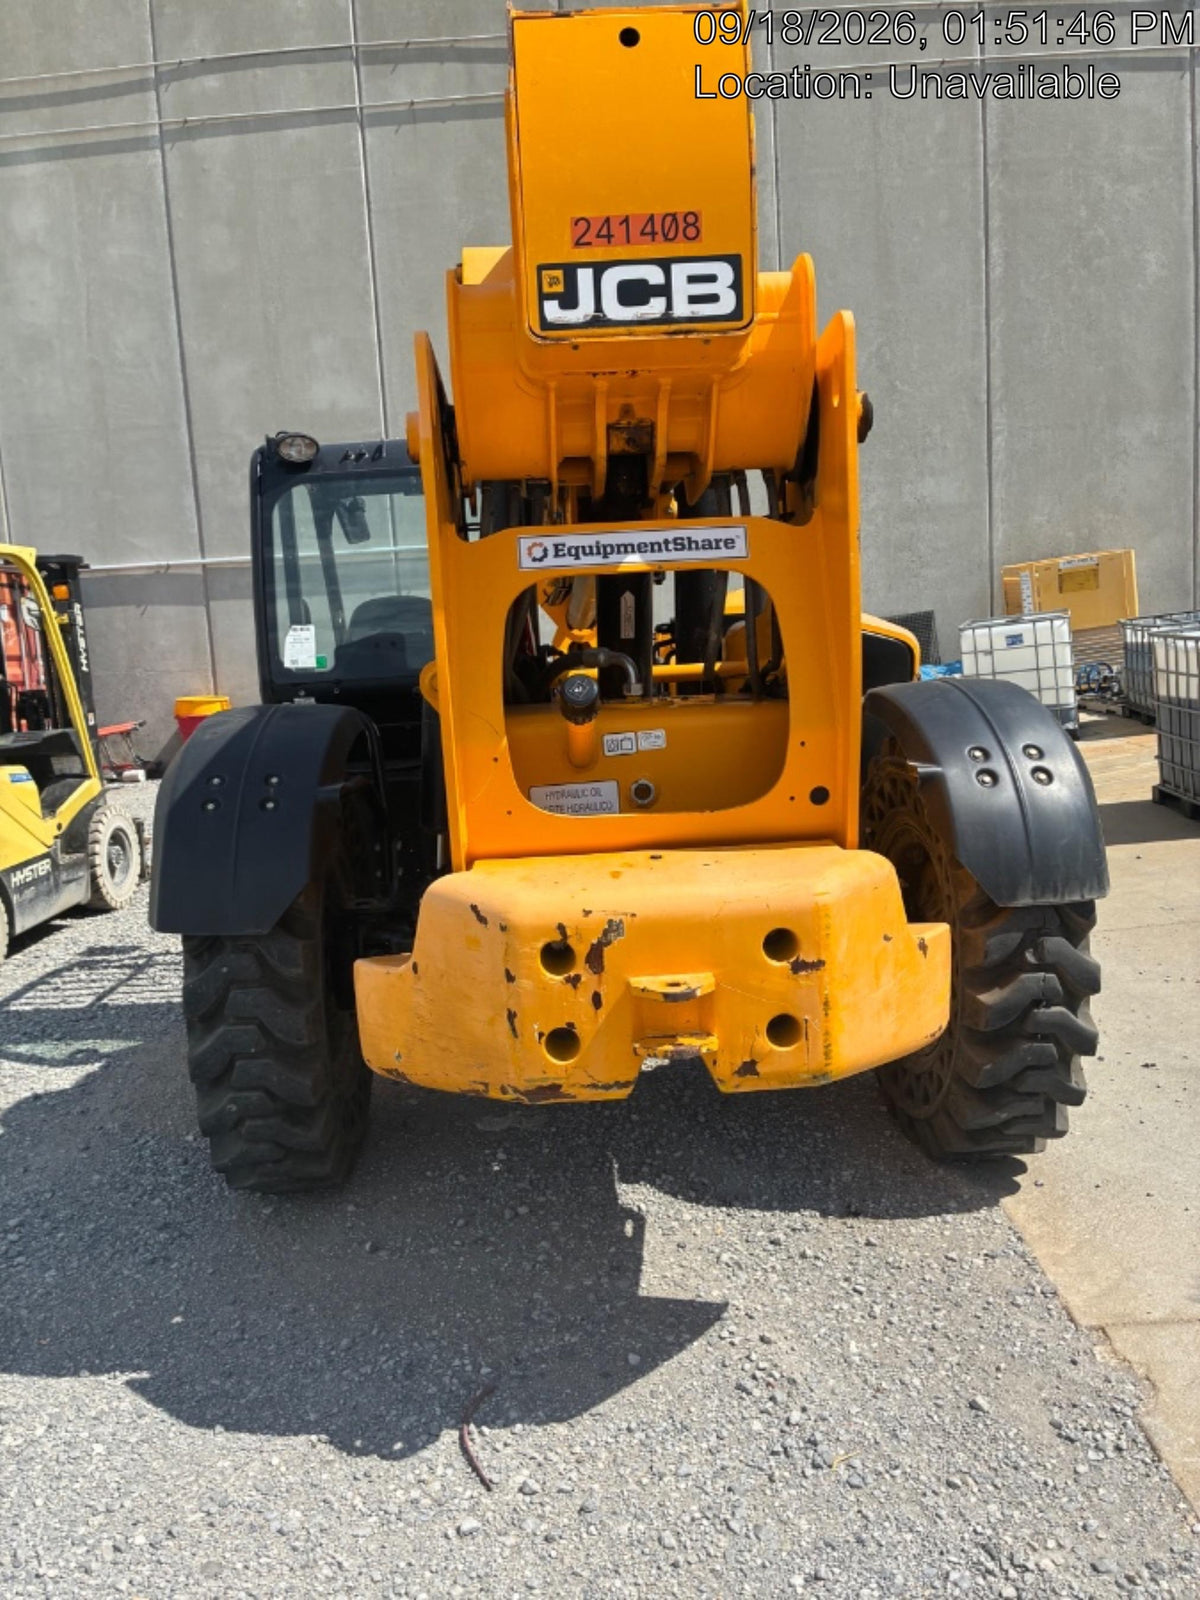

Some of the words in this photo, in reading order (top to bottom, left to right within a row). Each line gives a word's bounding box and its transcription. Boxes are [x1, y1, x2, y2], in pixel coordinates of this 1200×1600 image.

[573, 211, 701, 247] 241408
[543, 260, 737, 324] JCB
[552, 536, 737, 561] EquipmentShare
[73, 602, 90, 673] HYSTER
[544, 788, 589, 801] HYDRAULIC
[589, 786, 604, 798] OIL
[10, 858, 53, 888] HYSTER
